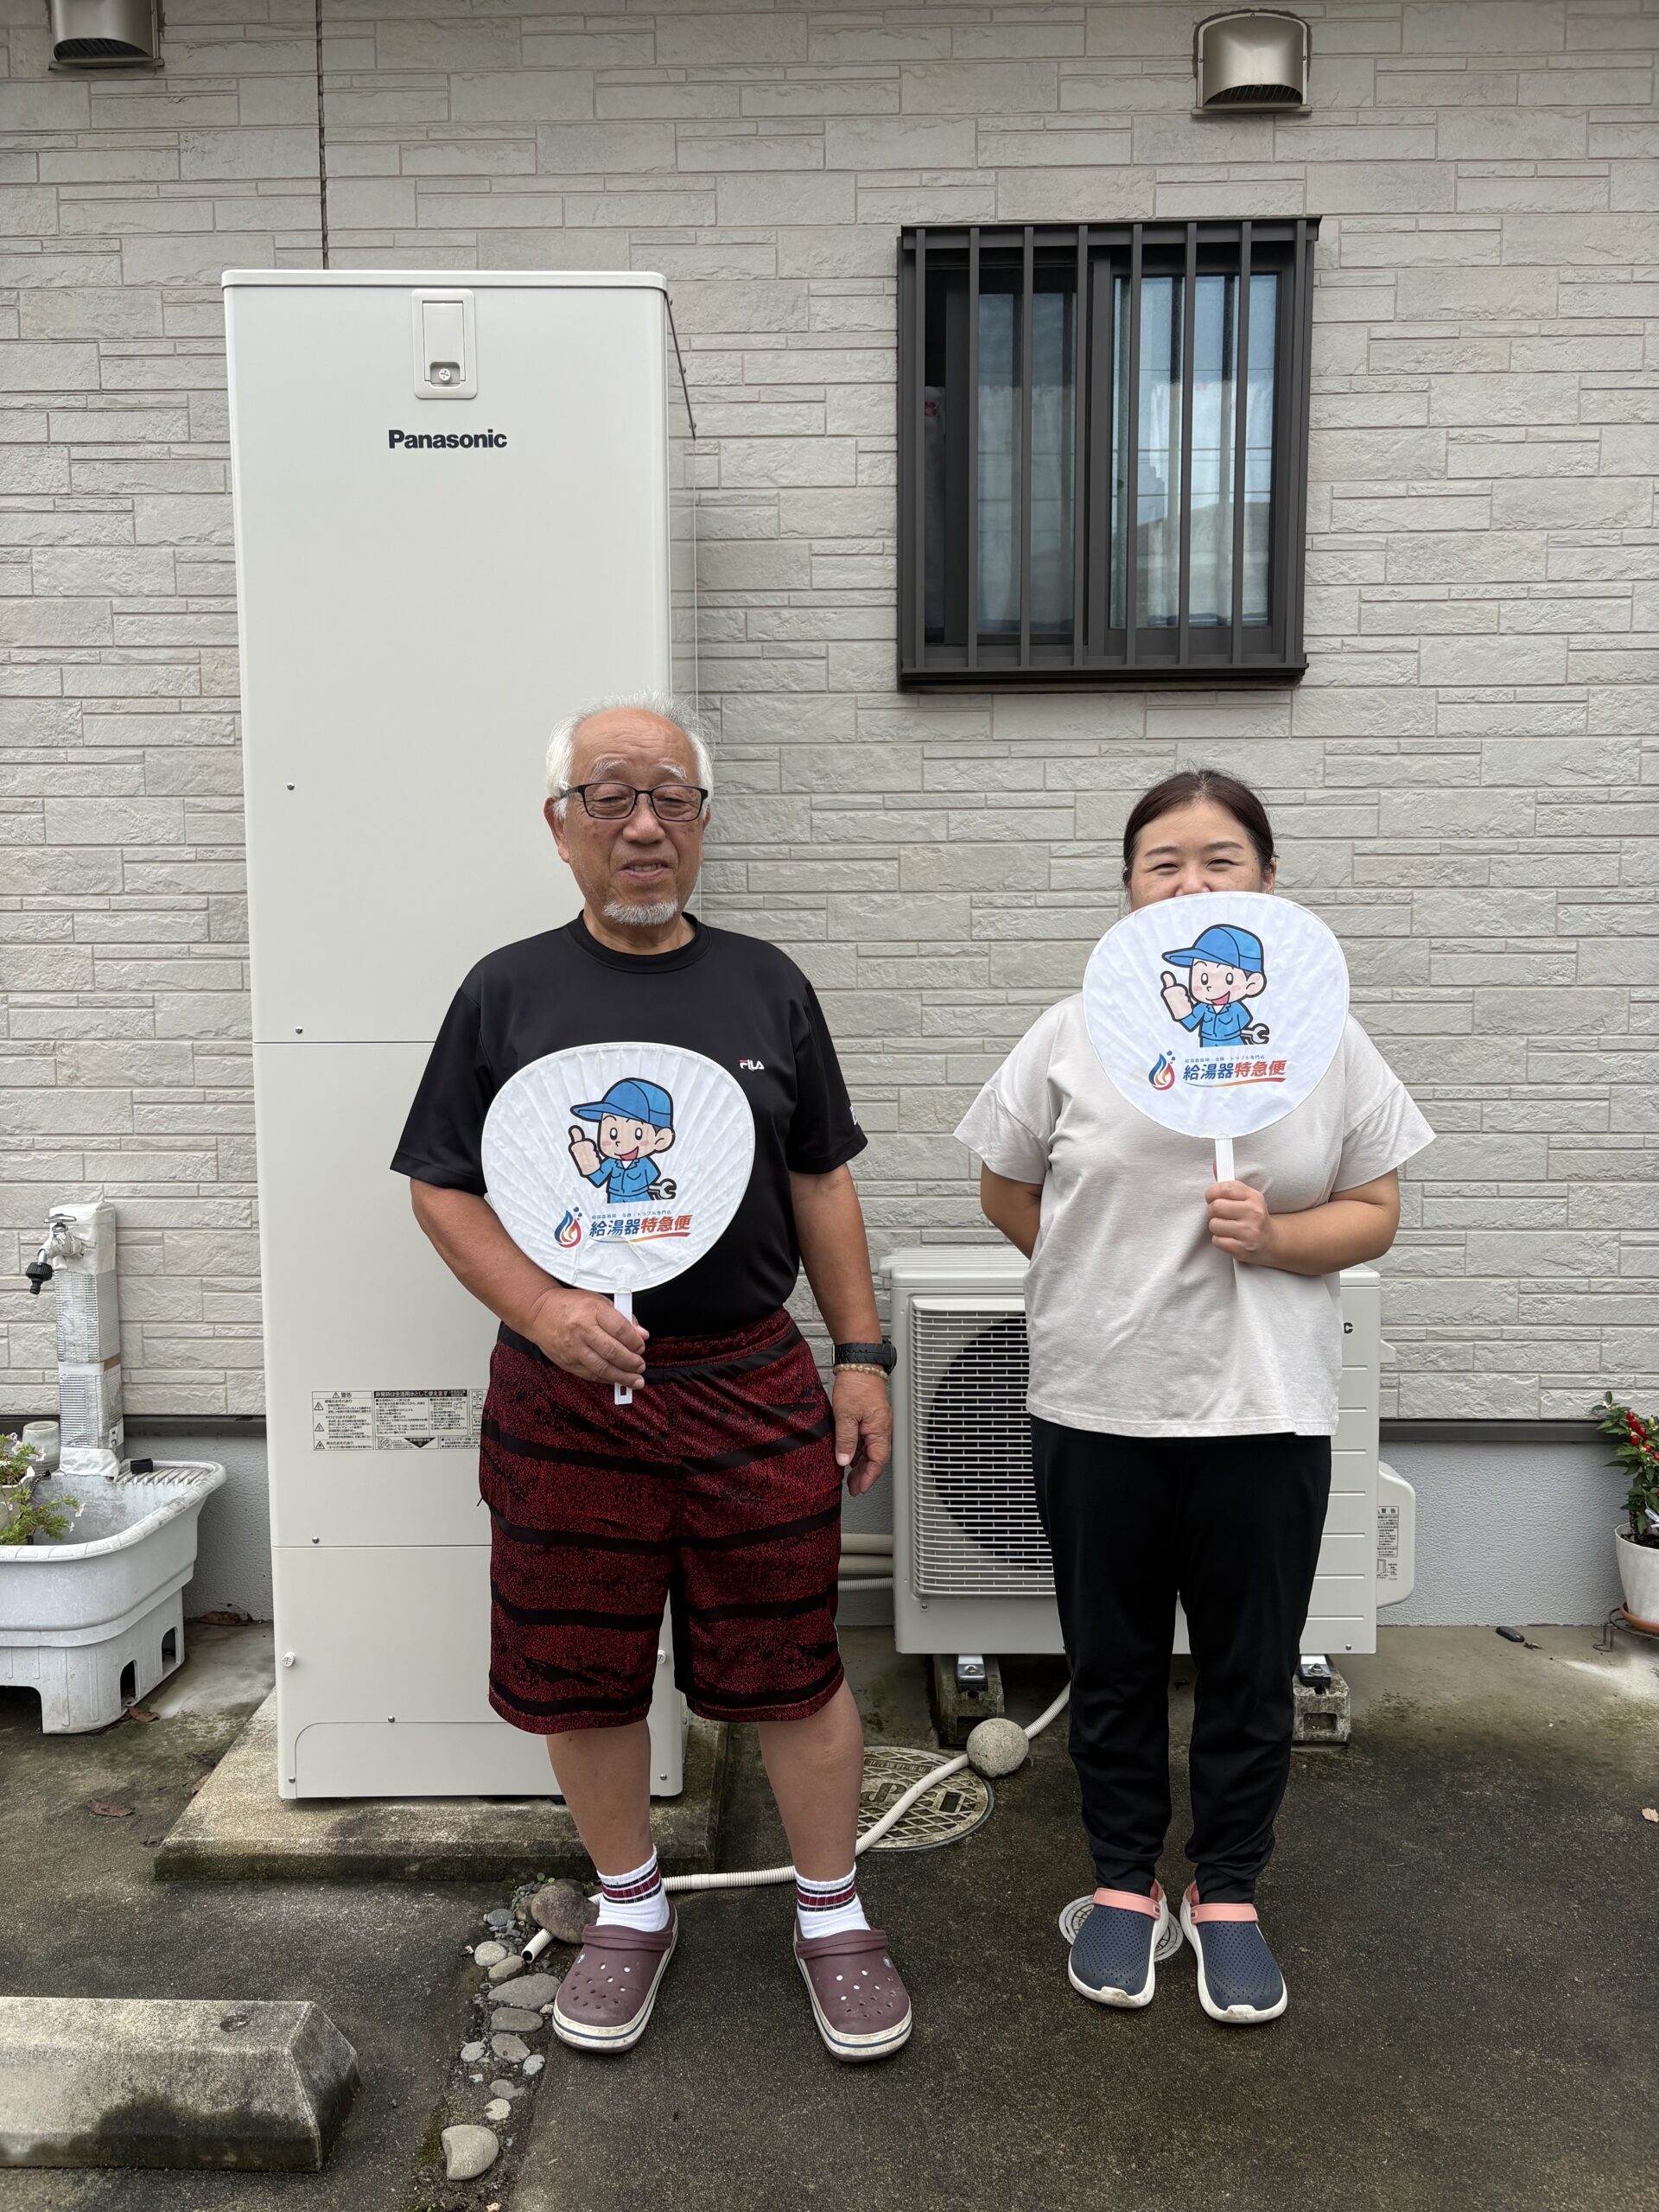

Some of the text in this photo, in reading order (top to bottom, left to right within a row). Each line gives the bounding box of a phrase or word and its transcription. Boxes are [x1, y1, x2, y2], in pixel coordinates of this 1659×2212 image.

[388, 429, 508, 449] Panasonic
[739, 1058, 765, 1071] FILA
[1183, 1059, 1287, 1081] 給湯器特急便
[589, 1214, 693, 1237] 給湯器特急便
